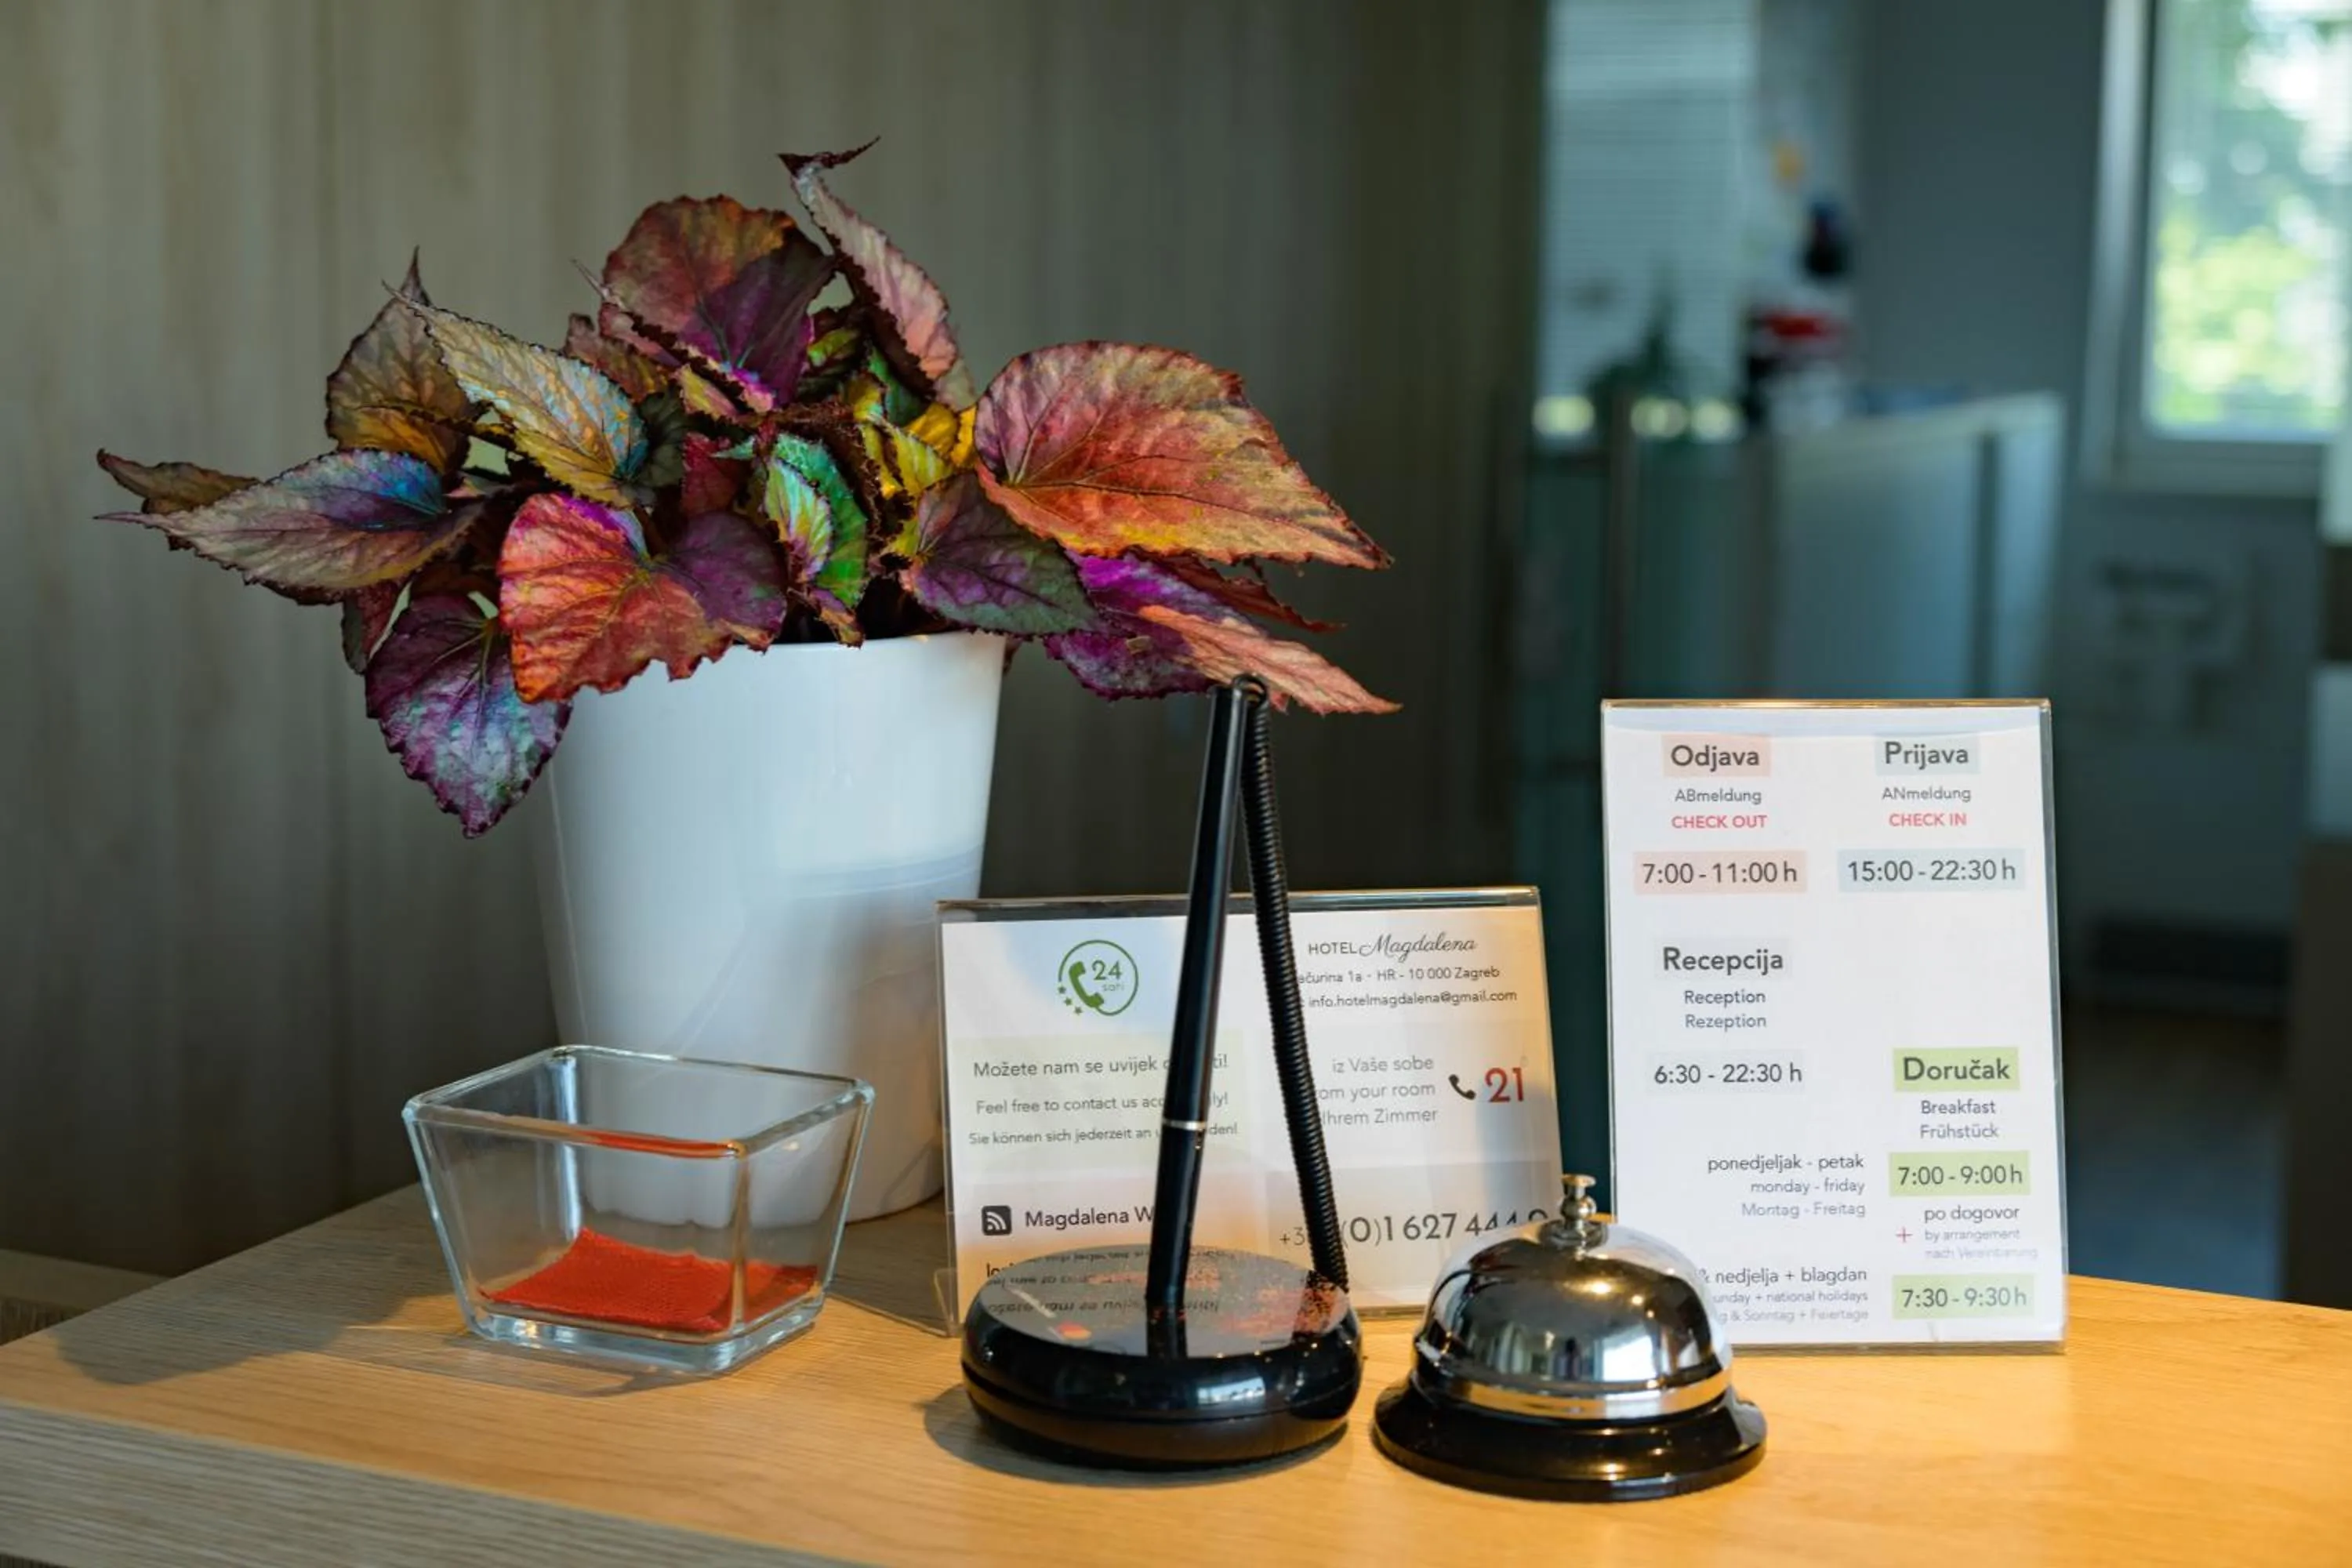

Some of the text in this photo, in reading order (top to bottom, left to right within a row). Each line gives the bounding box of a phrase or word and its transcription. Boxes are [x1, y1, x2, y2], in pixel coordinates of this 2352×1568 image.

[1671, 744, 1759, 771] Odjava
[1885, 741, 1969, 769] Prijava
[1675, 789, 1761, 804] ABmeldung
[1882, 787, 1971, 803] ANmeldung
[1671, 815, 1767, 829] CHECK OUT
[1889, 813, 1967, 826] CHECK IN
[1642, 863, 1693, 884] 7:00
[1714, 862, 1778, 883] 11:00
[1784, 862, 1797, 882] h
[1849, 861, 1913, 881] 15:00
[1931, 860, 1996, 880] 22:30
[2002, 859, 2015, 880] h
[1308, 932, 1476, 963] HOTEL Magdalena
[1091, 960, 1122, 980] 24
[1664, 947, 1784, 975] Recepcija
[1377, 970, 1396, 981] HR
[1410, 968, 1424, 979] 10
[1455, 967, 1500, 981] Zagreb
[1685, 989, 1766, 1007] Reception
[1686, 1014, 1766, 1031] Rezeption
[974, 1062, 1037, 1076] Možete
[1044, 1062, 1079, 1075] nam
[1085, 1062, 1102, 1073] se
[1109, 1057, 1157, 1076] uvijek
[1334, 1056, 1434, 1073] iz Vaše sobe
[1654, 1065, 1700, 1083] 6:30
[1723, 1063, 1782, 1083] 22:30
[1790, 1062, 1802, 1082] h
[1904, 1057, 2009, 1081] Doručak
[1350, 1087, 1385, 1102] your
[1392, 1083, 1435, 1097] room
[1485, 1067, 1524, 1102] 21
[977, 1101, 1007, 1114] Feel
[1012, 1100, 1039, 1112] free
[1045, 1100, 1058, 1111] to
[1064, 1097, 1116, 1111] contact
[1122, 1097, 1138, 1109] us
[1921, 1100, 1994, 1115] Breakfast
[1374, 1108, 1437, 1123] Zimmer
[969, 1133, 989, 1145] Sie
[993, 1131, 1041, 1143] können
[1046, 1130, 1070, 1142] sich
[1075, 1128, 1132, 1143] jederzeit
[1135, 1129, 1151, 1139] an
[1920, 1123, 1998, 1139] Frühstück
[1708, 1154, 1802, 1174] ponedjeljak
[1819, 1154, 1864, 1172] petak
[1898, 1167, 1944, 1185] 7:00
[1961, 1167, 2007, 1185] 9:00
[2010, 1165, 2022, 1184] h
[1751, 1180, 1809, 1196] monday
[1824, 1179, 1865, 1195] friday
[1025, 1208, 1129, 1230] Magdalena
[1742, 1203, 1800, 1219] Montag
[1814, 1202, 1865, 1218] Freitag
[1924, 1205, 2020, 1223] po dogovor
[1404, 1214, 1457, 1240] 627
[1925, 1230, 1938, 1242] by
[1715, 1268, 1779, 1287] nedjelja
[1801, 1267, 1867, 1286] blagdan
[1713, 1293, 1750, 1305] unday
[1767, 1291, 1815, 1302] national
[1818, 1291, 1867, 1303] holidays
[1901, 1288, 1947, 1308] 7:30
[1964, 1287, 2011, 1306] 9:30
[2015, 1287, 2027, 1305] h
